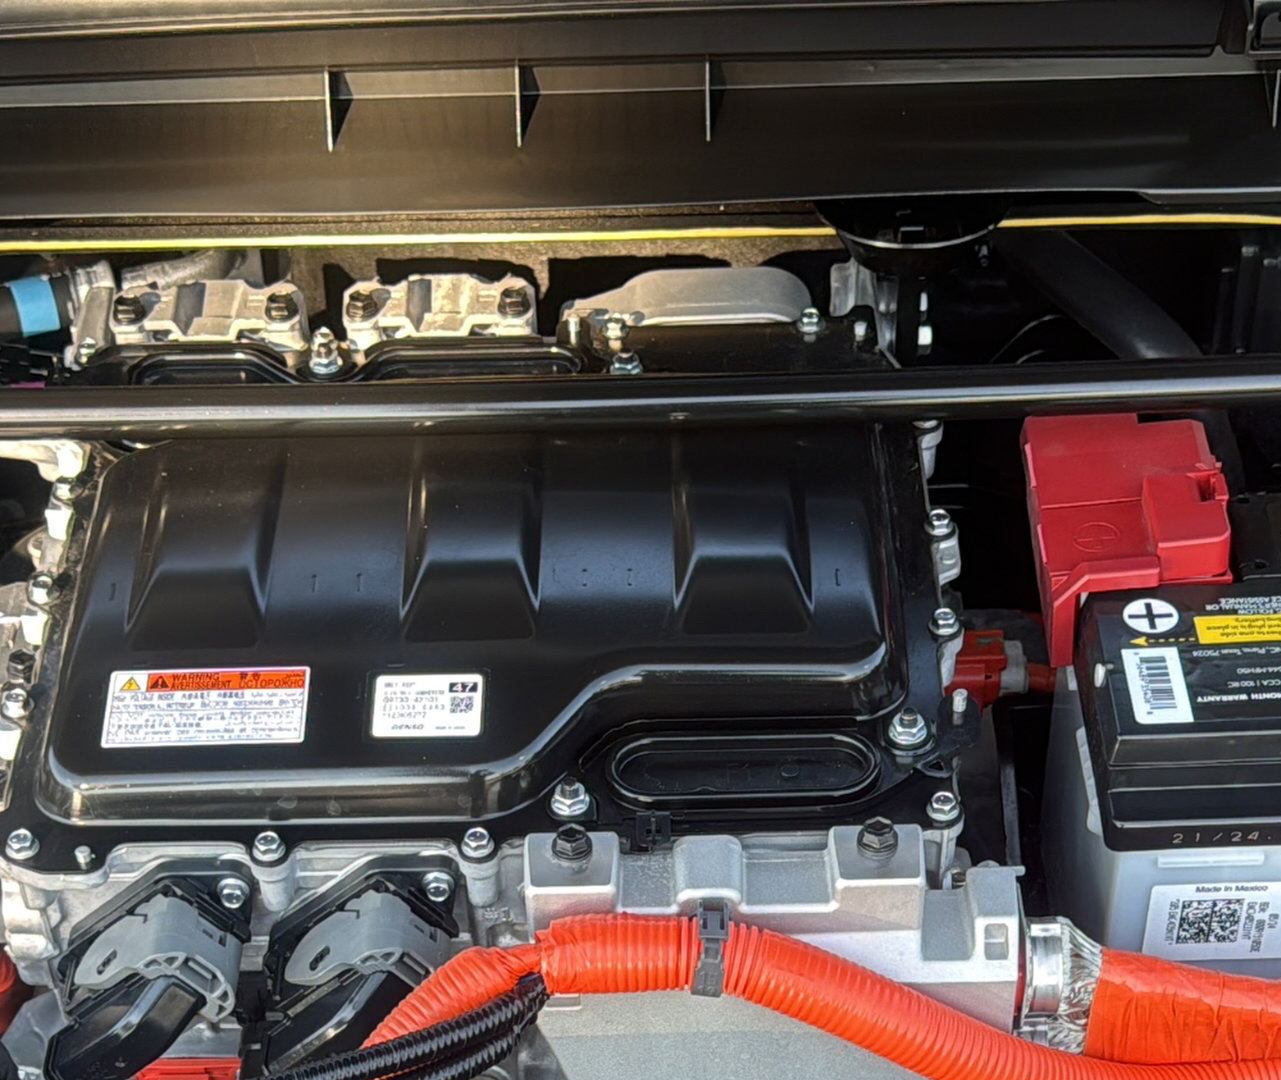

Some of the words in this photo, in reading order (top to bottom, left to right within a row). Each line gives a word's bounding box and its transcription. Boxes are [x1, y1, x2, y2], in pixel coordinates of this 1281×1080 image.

[172, 673, 220, 682] WARNING
[171, 680, 232, 690] AVERTISSEMENT
[239, 678, 305, 688] ОСТОРОЖНО
[452, 683, 474, 692] 47
[1197, 694, 1248, 702] WARRANTY
[1195, 885, 1222, 893] Made
[1234, 884, 1269, 892] Mexico
